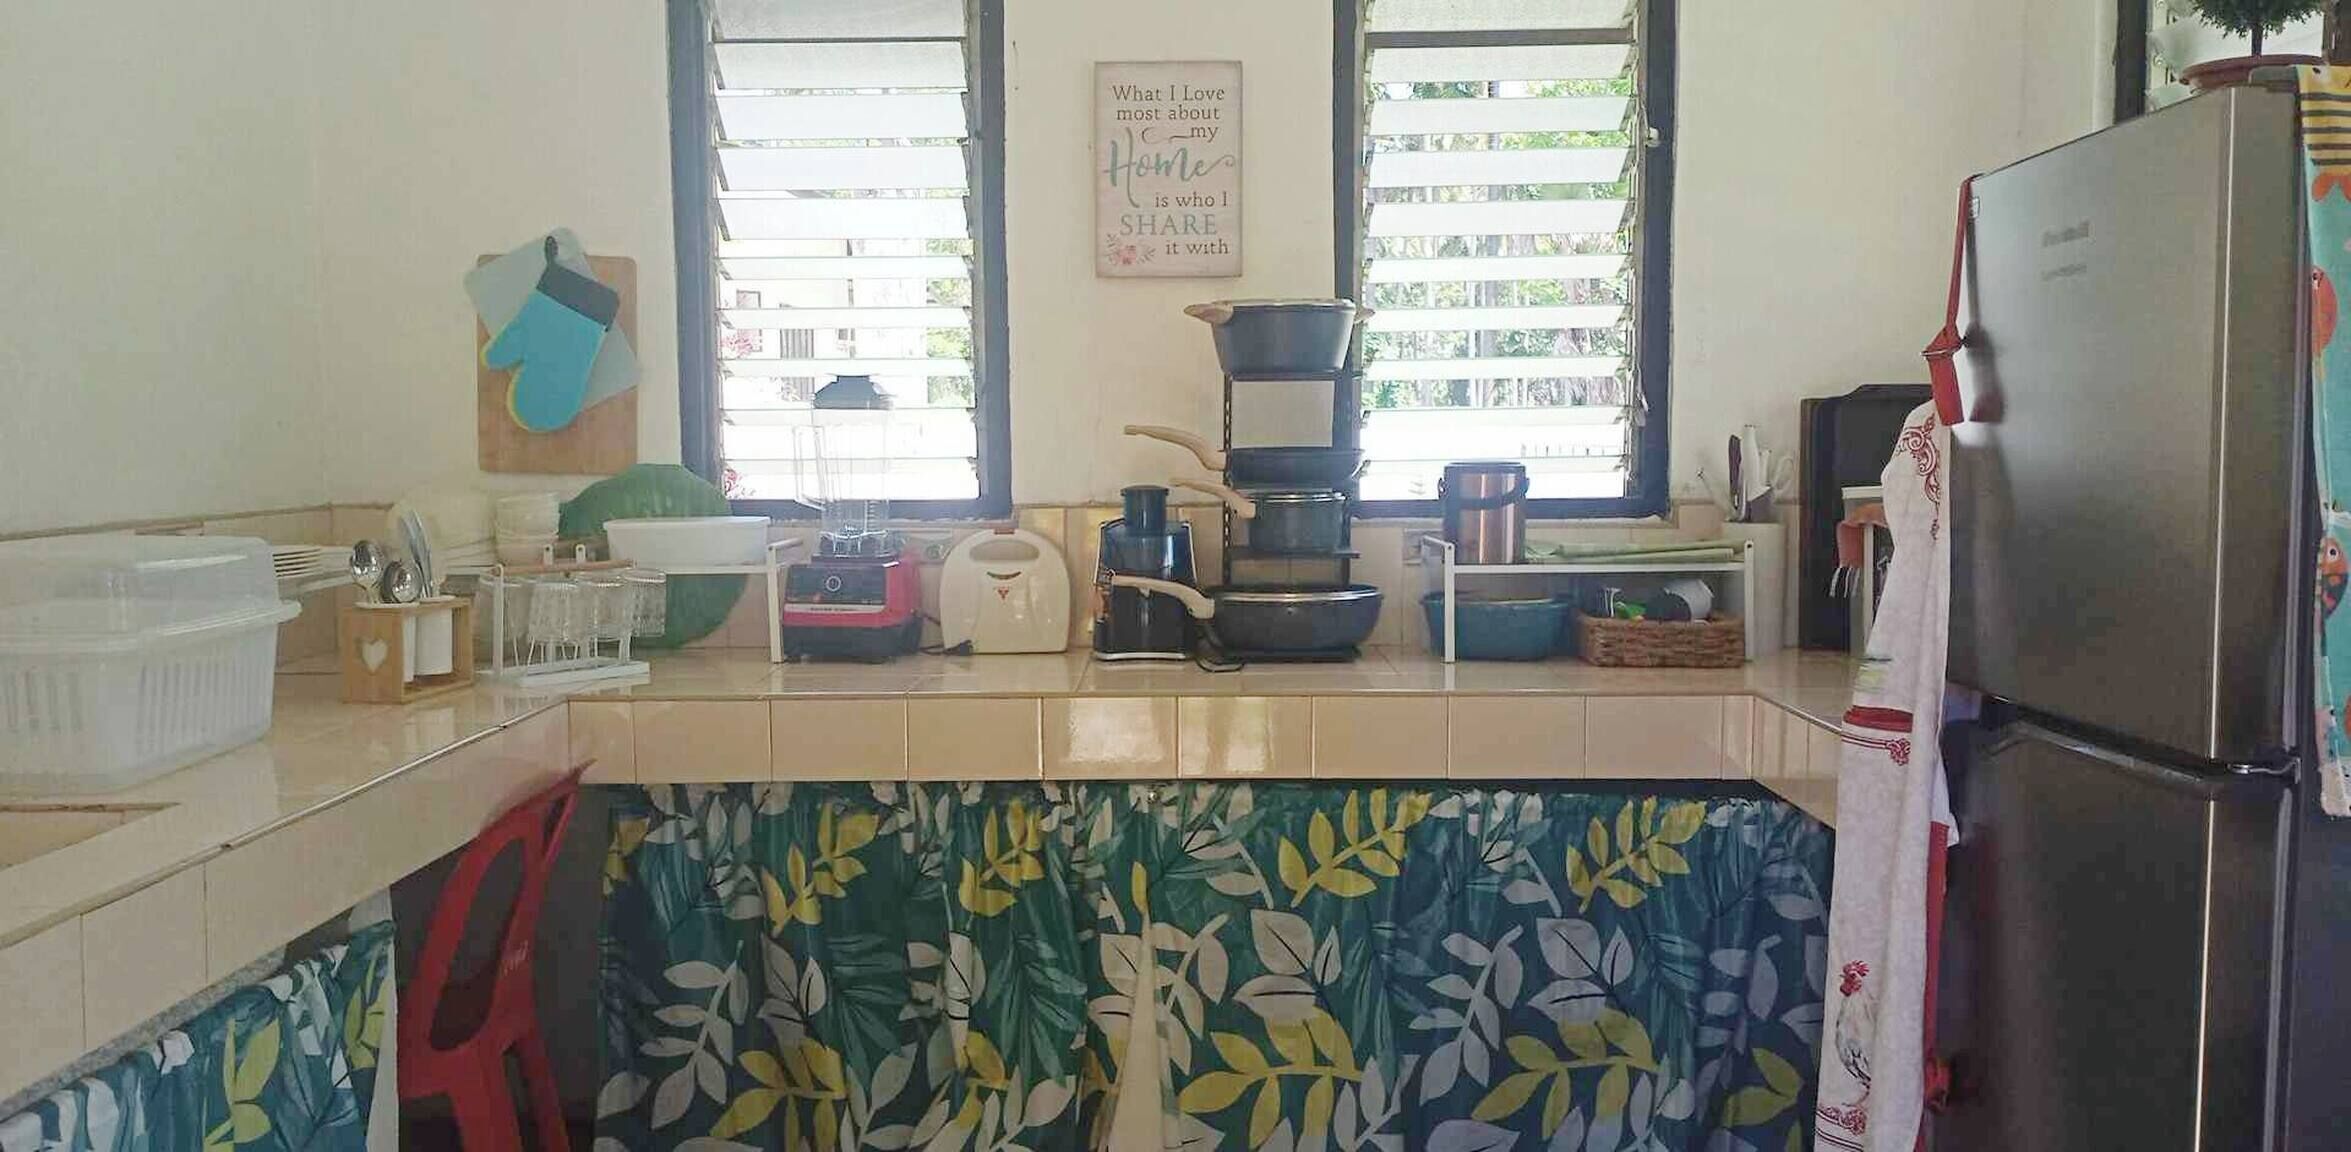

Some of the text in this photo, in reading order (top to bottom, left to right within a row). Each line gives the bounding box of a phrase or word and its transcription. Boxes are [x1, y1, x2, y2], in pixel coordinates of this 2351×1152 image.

[1112, 85, 1225, 101] What I Love
[1116, 104, 1220, 121] most about
[1190, 126, 1219, 143] my
[1103, 127, 1236, 208] Home
[1155, 191, 1228, 208] is who I
[1119, 214, 1219, 236] SHARE
[1166, 239, 1230, 255] it with
